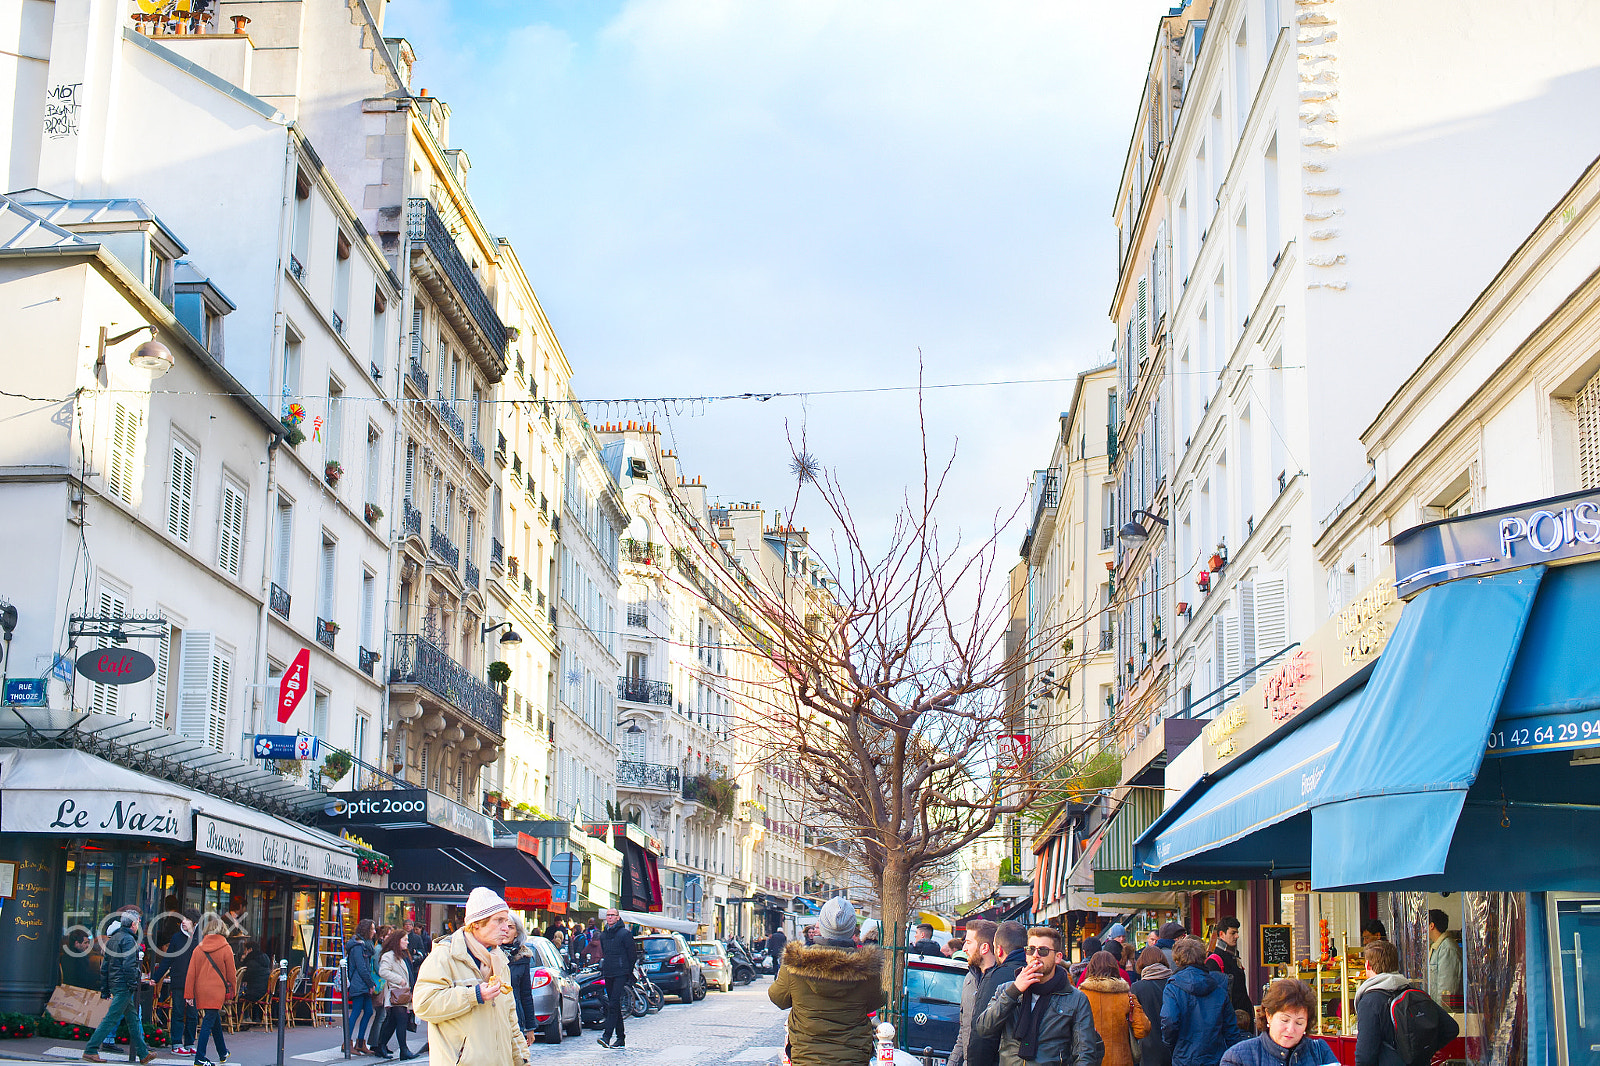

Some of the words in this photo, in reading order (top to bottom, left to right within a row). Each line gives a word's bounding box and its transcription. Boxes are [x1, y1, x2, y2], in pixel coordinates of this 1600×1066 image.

[98, 655, 134, 677] Café
[283, 664, 304, 706] TABAC
[1488, 732, 1505, 748] 01
[1510, 728, 1530, 746] 42
[1534, 725, 1555, 743] 64
[1557, 722, 1578, 741] 29
[1581, 719, 1600, 738] 94
[50, 799, 89, 829] Le
[100, 800, 179, 836] Nazir
[335, 797, 380, 819] Optic
[382, 798, 425, 813] 2000
[206, 821, 244, 857] Brasserie
[262, 836, 279, 865] Café
[281, 846, 290, 866] Le
[324, 853, 352, 881] Brasserie
[390, 882, 421, 891] COCO
[427, 883, 464, 892] BAZAR
[1120, 875, 1159, 888] COURS
